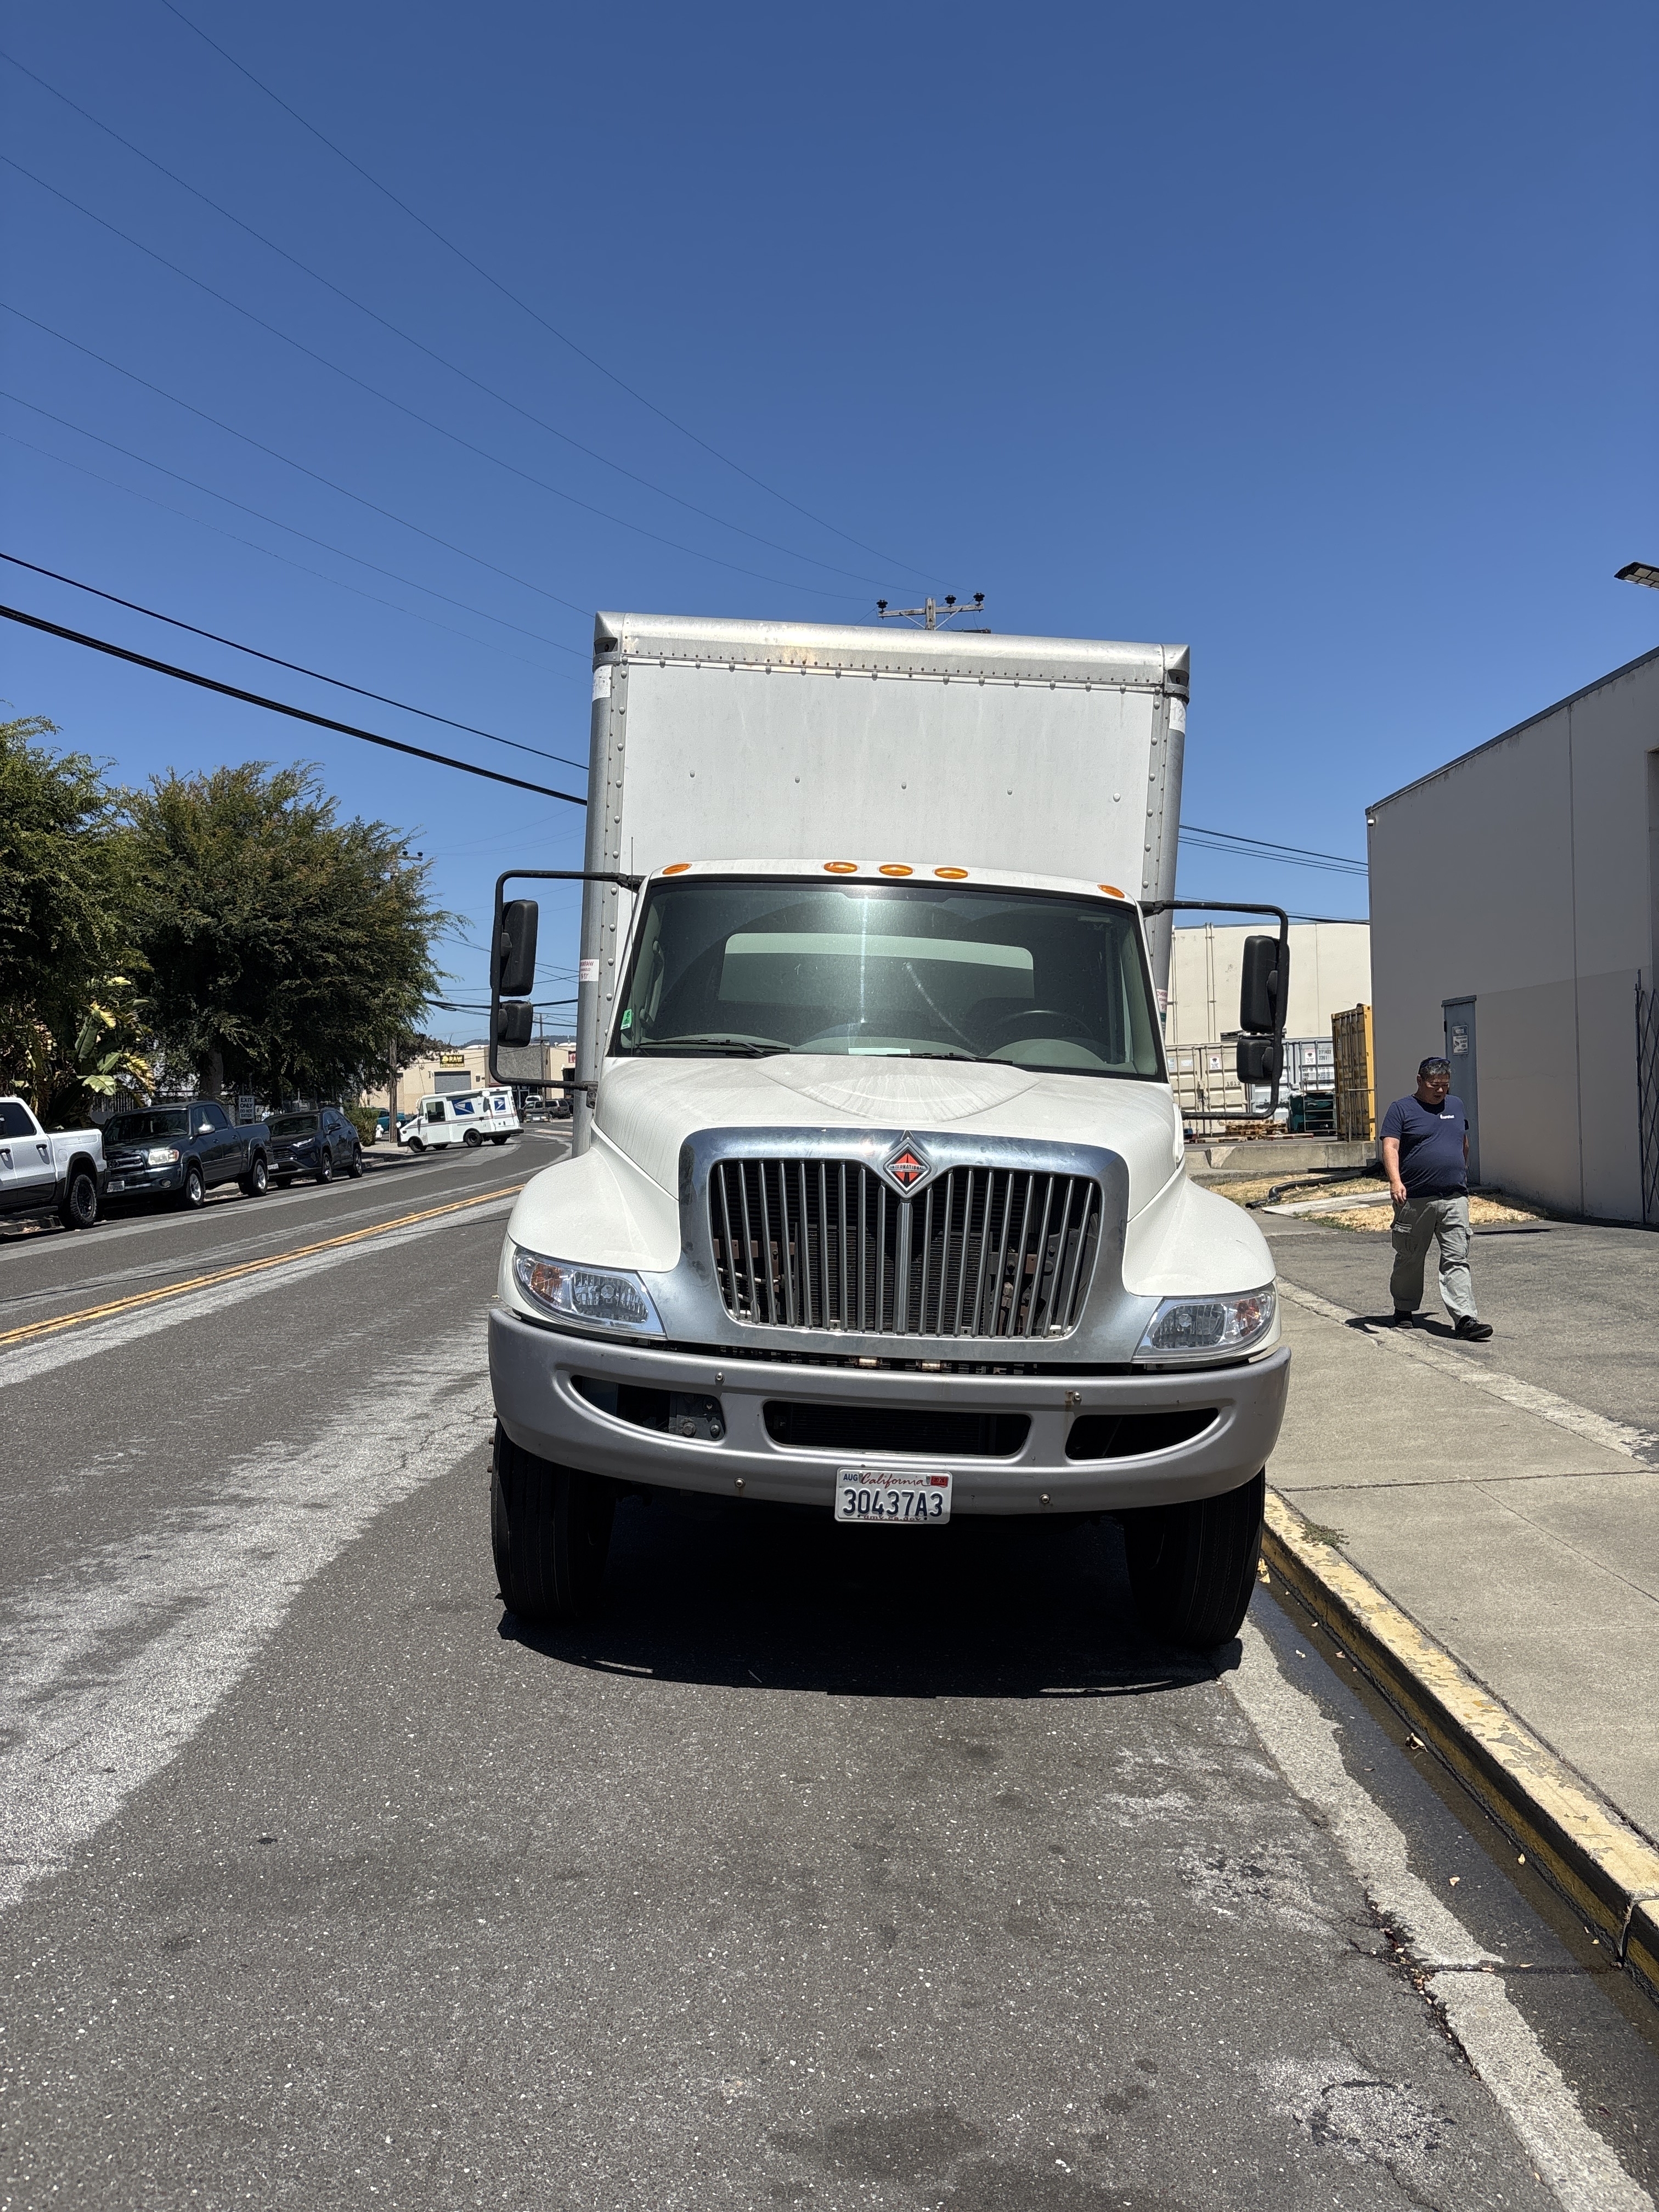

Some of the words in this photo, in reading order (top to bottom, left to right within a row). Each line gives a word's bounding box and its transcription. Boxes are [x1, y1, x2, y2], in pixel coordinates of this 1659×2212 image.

[843, 1473, 858, 1482] AUG
[861, 1472, 929, 1488] California
[843, 1488, 943, 1517] 30437A3
